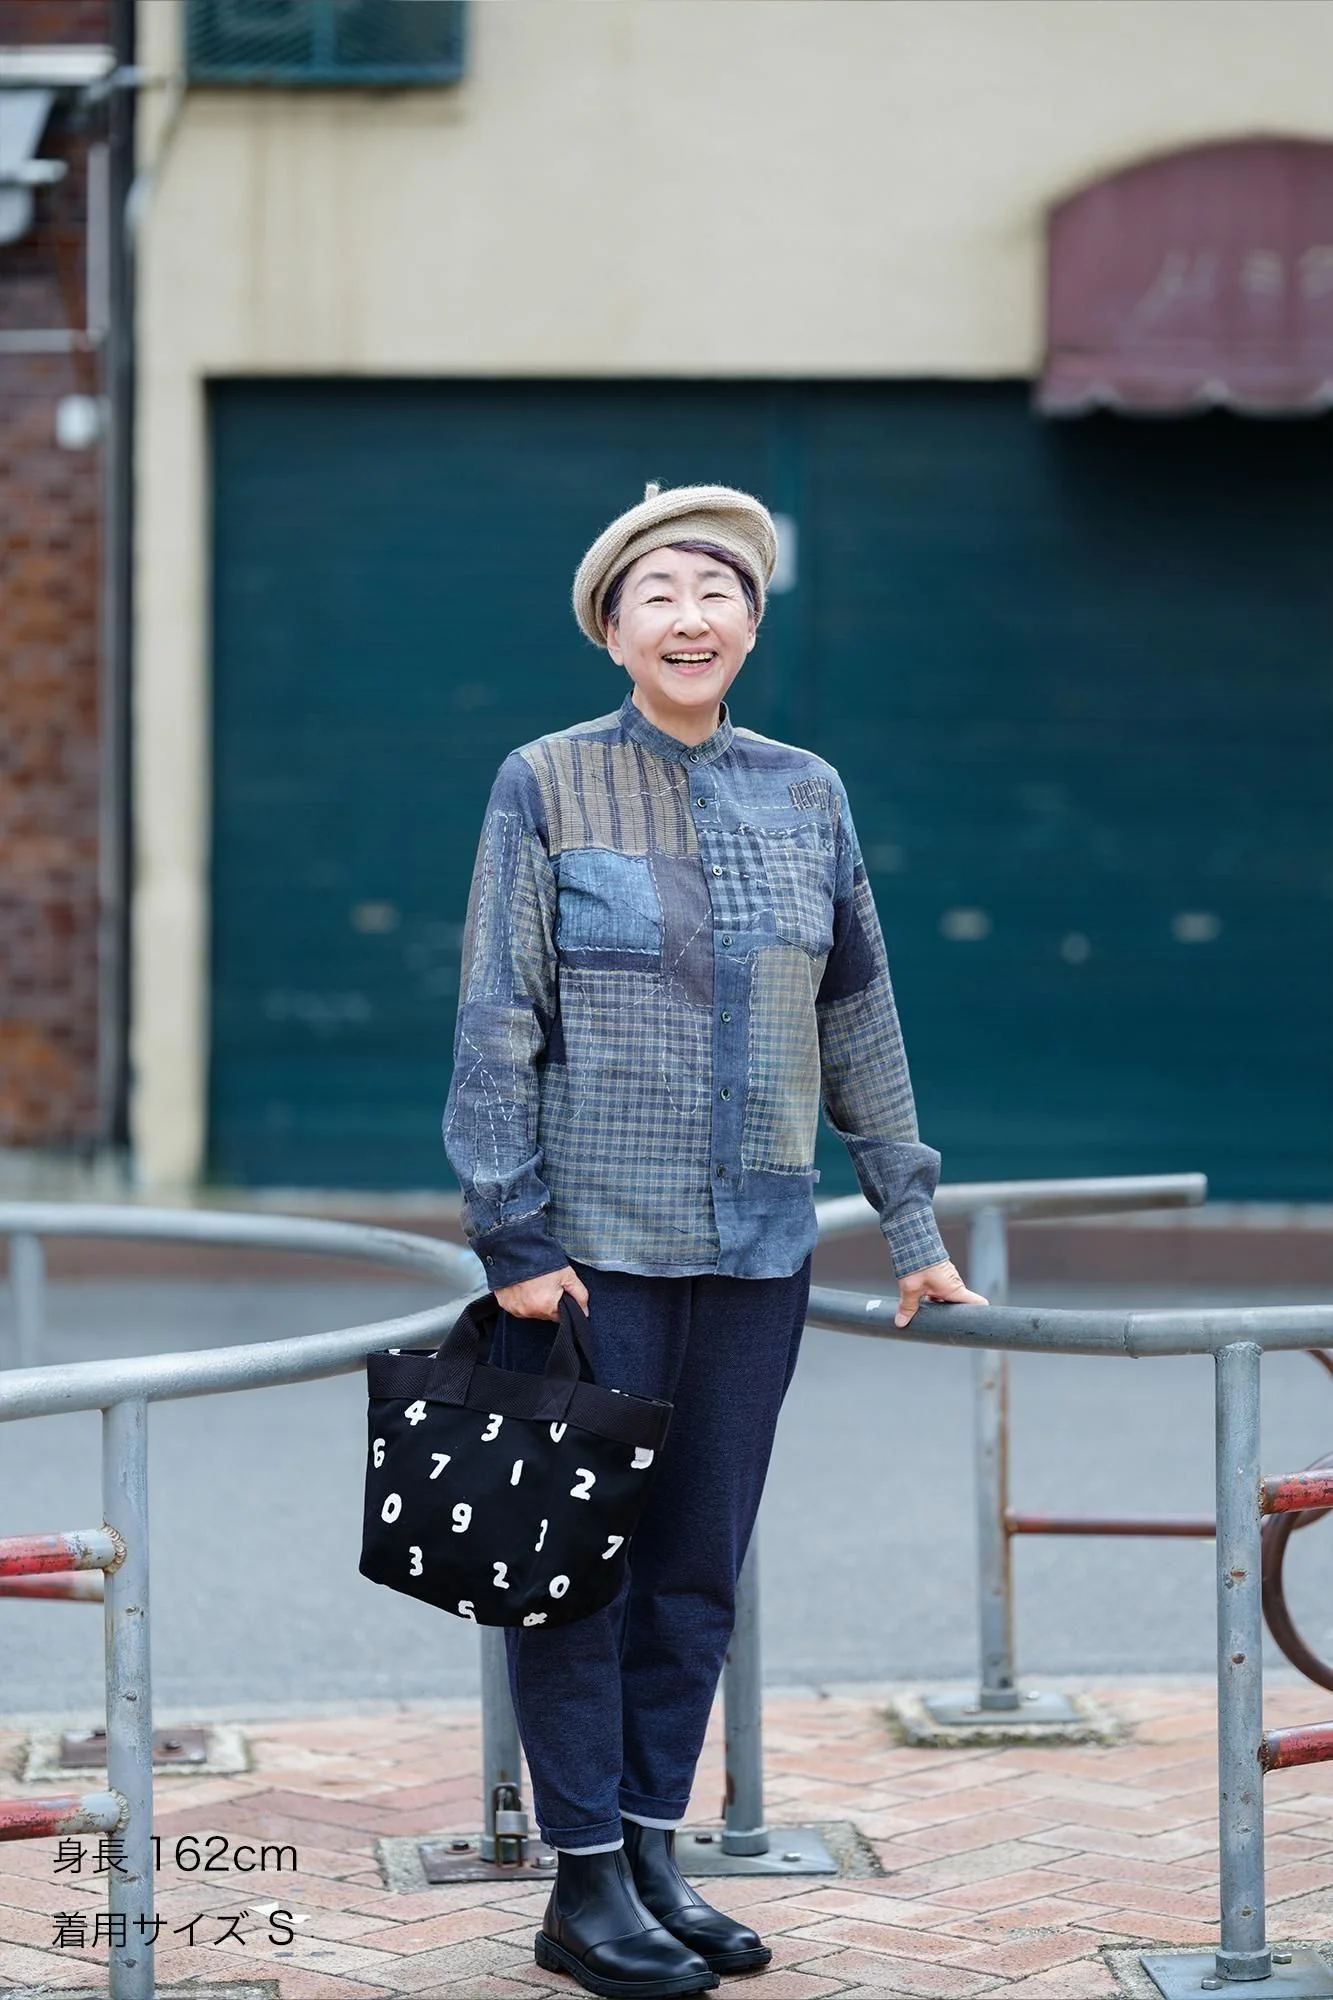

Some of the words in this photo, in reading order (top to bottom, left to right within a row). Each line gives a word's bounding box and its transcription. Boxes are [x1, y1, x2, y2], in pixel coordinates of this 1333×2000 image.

[404, 1400, 428, 1426] 4
[481, 1414, 503, 1442] 3
[373, 1438, 385, 1469] 6
[429, 1453, 451, 1480] 7
[510, 1459, 523, 1486] 1
[570, 1468, 596, 1501] 2
[381, 1493, 402, 1524] 0
[452, 1503, 472, 1533] 9
[409, 1546, 423, 1577] 3
[602, 1535, 624, 1560] 7
[493, 1562, 510, 1590] 2
[549, 1575, 570, 1599] 0
